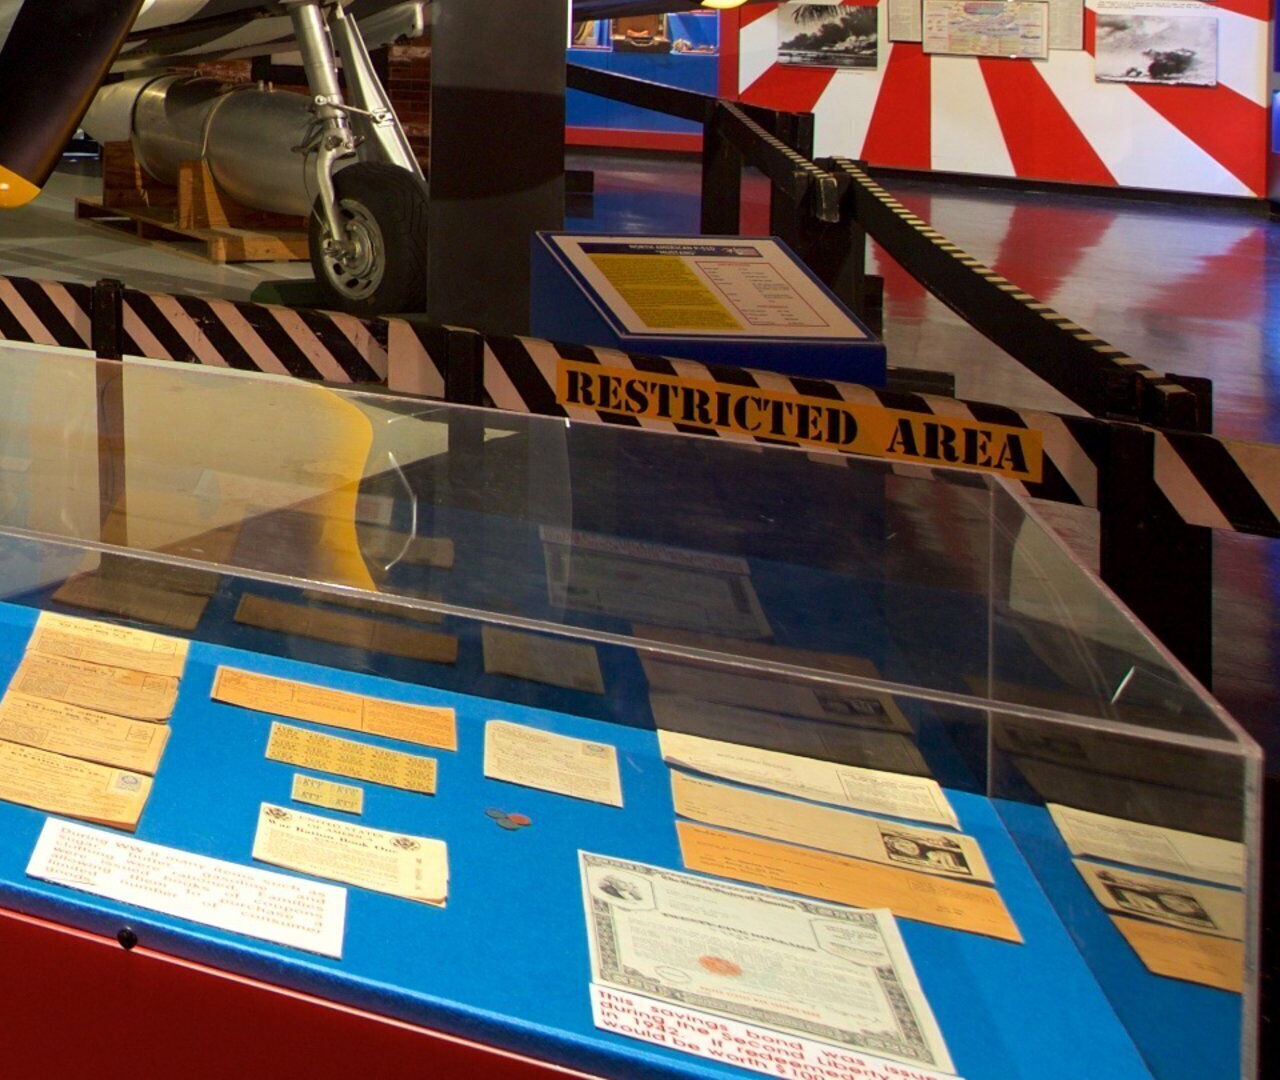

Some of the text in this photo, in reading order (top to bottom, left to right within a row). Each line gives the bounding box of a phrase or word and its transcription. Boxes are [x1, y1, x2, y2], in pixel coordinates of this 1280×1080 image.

[565, 369, 1028, 473] RESTRICTED AREA
[599, 990, 867, 1067] This savings bond was
[599, 1000, 666, 1024] during
[681, 1018, 709, 1036] the
[722, 1028, 806, 1060] Second
[600, 1011, 852, 1080] in redeemed
[603, 1020, 768, 1070] would be worth
